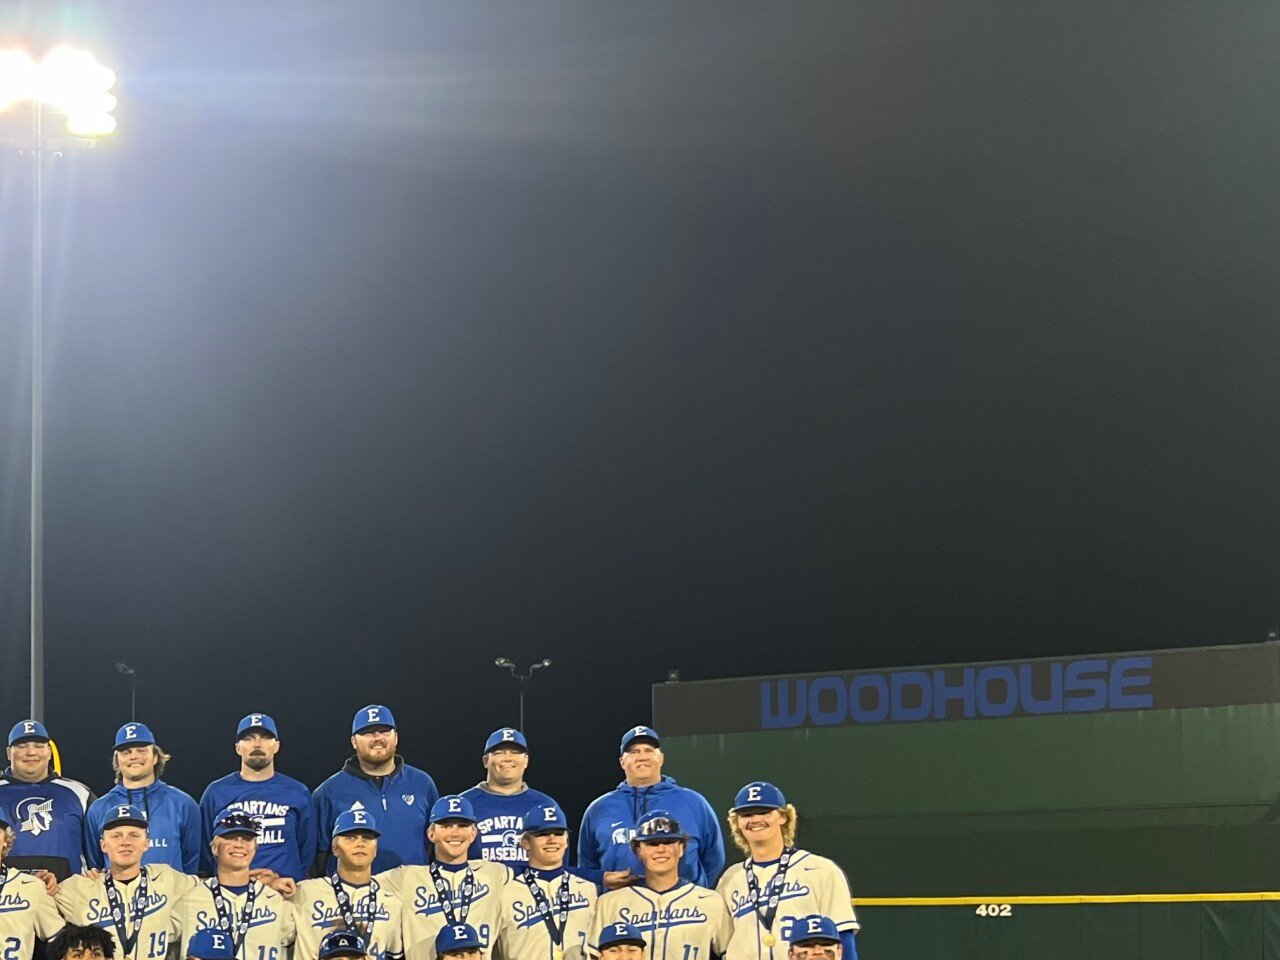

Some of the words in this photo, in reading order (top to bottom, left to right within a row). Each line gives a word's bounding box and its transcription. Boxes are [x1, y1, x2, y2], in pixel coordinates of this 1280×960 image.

[760, 656, 1154, 729] WOODHOUSE
[251, 714, 263, 726] E
[368, 708, 380, 722] E
[24, 721, 36, 734] E
[125, 726, 138, 739] E
[634, 726, 647, 737] E
[502, 730, 515, 742] E
[747, 787, 762, 801] E
[117, 806, 130, 818] E
[448, 799, 462, 812] E
[353, 811, 367, 824] E
[543, 807, 557, 821] E
[477, 815, 523, 834] SPARTA
[481, 847, 529, 862] BASEBAL
[975, 904, 1012, 917] 402
[615, 923, 628, 935] E
[807, 918, 822, 933] E
[452, 925, 468, 940] E
[147, 930, 167, 959] 19
[212, 934, 226, 949] E
